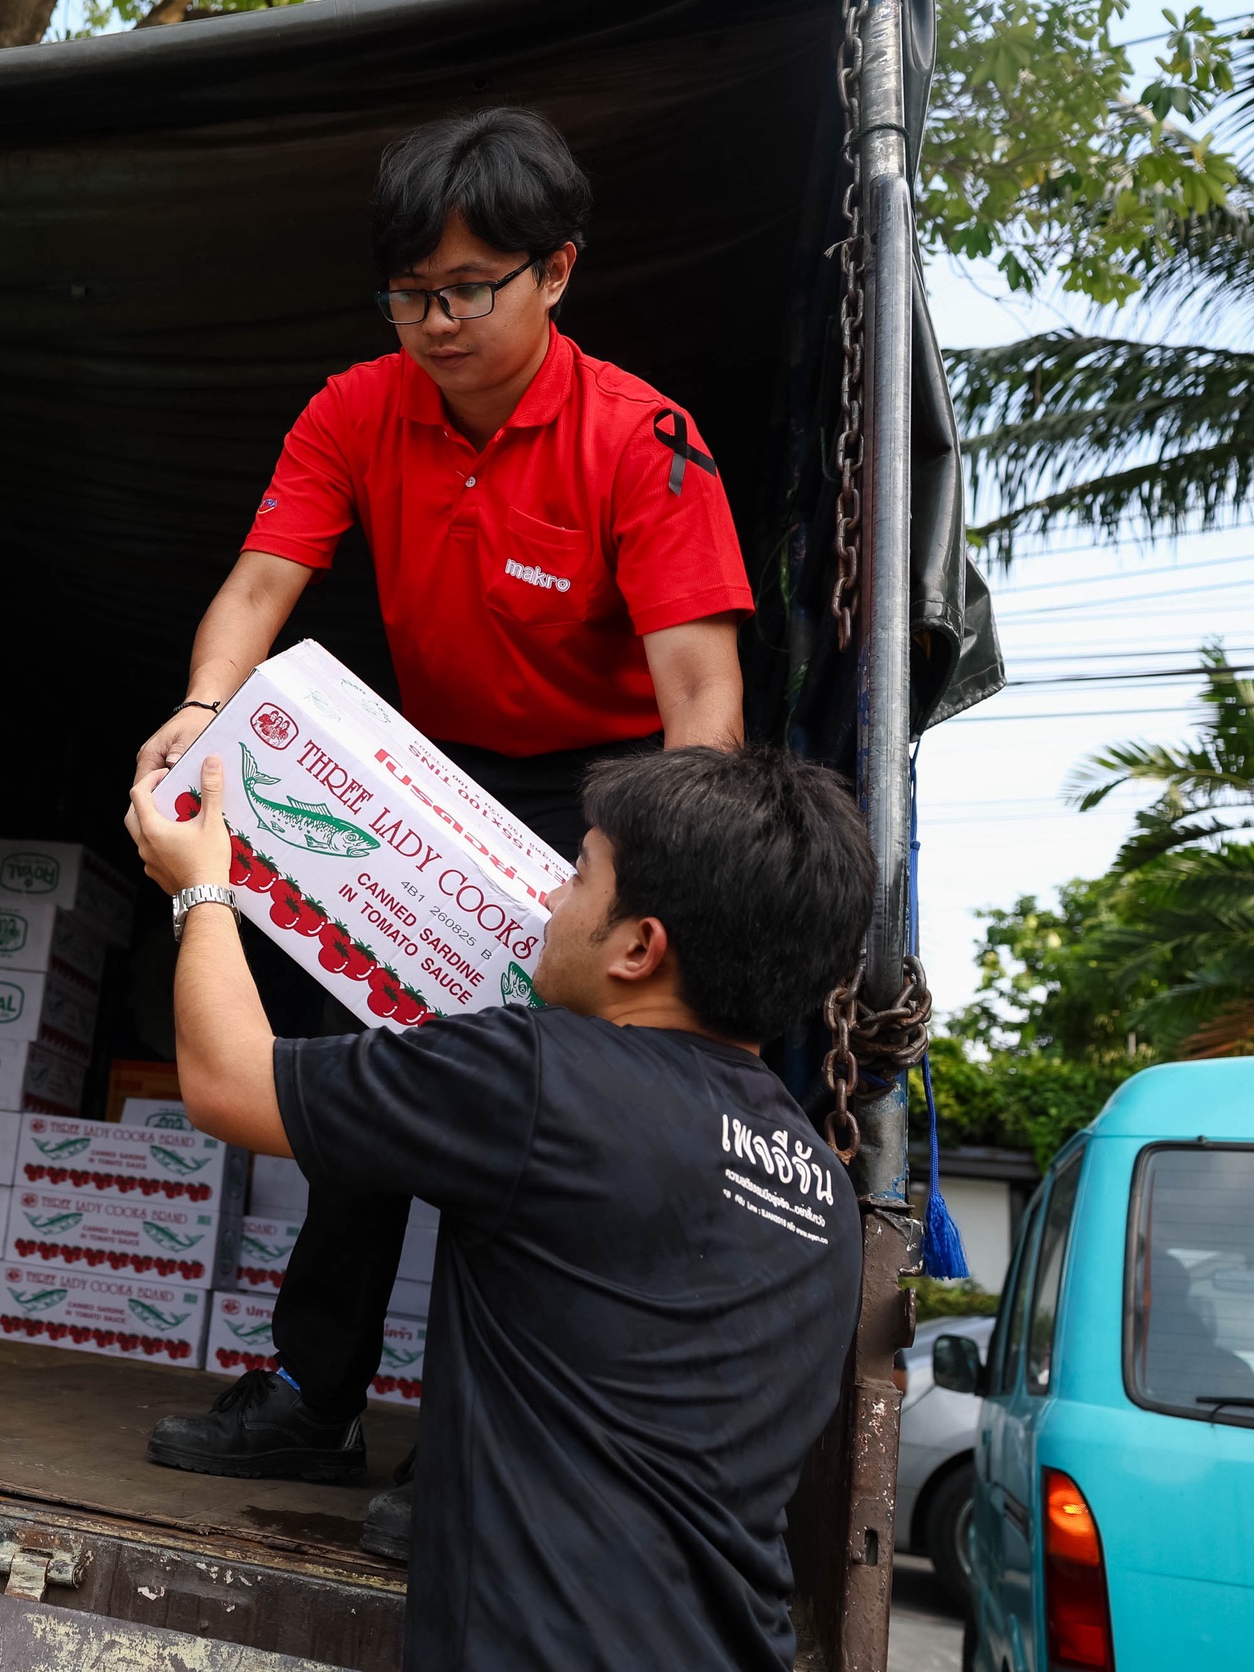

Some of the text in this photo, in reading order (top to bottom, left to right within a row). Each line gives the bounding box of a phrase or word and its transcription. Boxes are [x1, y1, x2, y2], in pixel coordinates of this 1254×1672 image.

[505, 558, 571, 592] makro
[408, 744, 452, 787] TINS
[374, 748, 548, 905] โปรดอย่า
[296, 739, 541, 961] THREE LADY COOKS
[7, 864, 56, 885] ROYAL
[540, 863, 567, 885] ET
[355, 872, 486, 987] CANNED SARDINE
[400, 879, 492, 961] 4B1 260825 B
[337, 883, 472, 1005] IN TOMATO SAUCE
[84, 1124, 111, 1138] LADY
[158, 1134, 195, 1148] BRAND
[722, 1114, 834, 1205] เพจอีจัน
[75, 1200, 103, 1214] LADY
[151, 1210, 188, 1225] BRAND
[60, 1275, 89, 1290] LADY
[136, 1286, 174, 1303] BRAND
